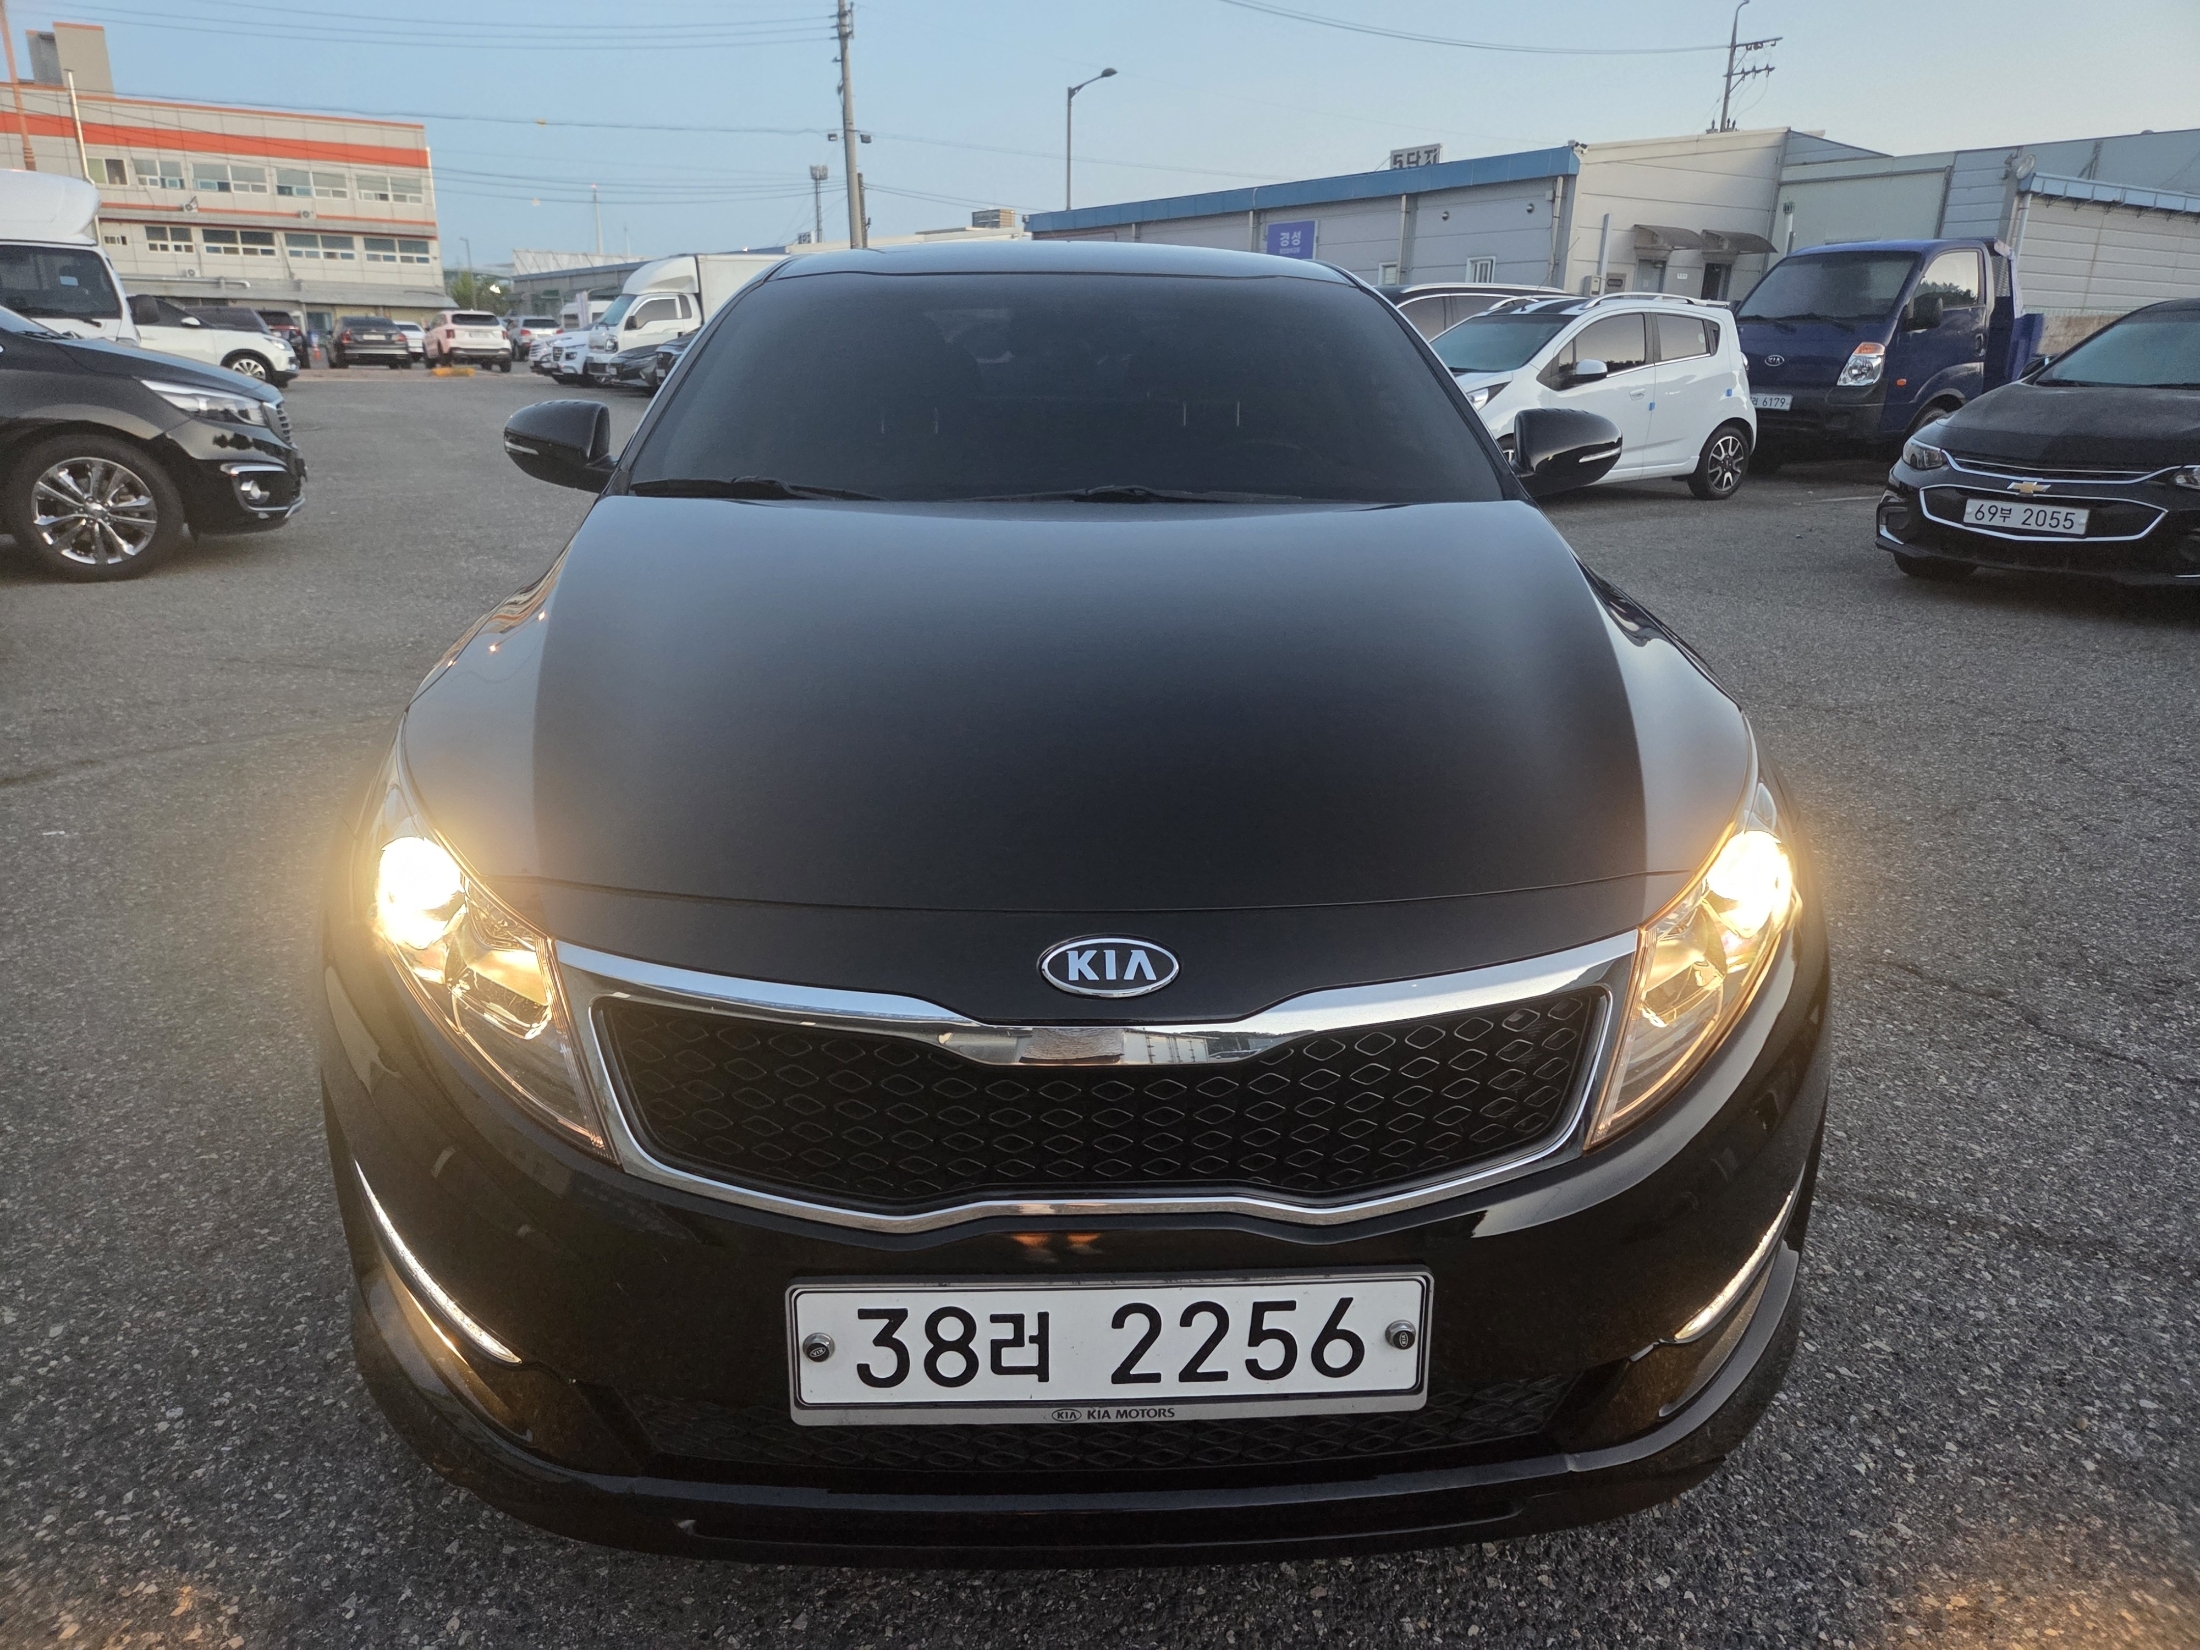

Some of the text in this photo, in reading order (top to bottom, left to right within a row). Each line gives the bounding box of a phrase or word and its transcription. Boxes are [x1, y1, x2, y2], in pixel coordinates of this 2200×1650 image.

[1280, 231, 1301, 247] 경성
[1762, 397, 1786, 408] 6179
[1974, 503, 2076, 530] 69부 2055
[1066, 949, 1157, 981] KIA
[856, 1296, 1366, 1389] 38러 2256
[1057, 1407, 1175, 1421] KIA KIA MOTORS
